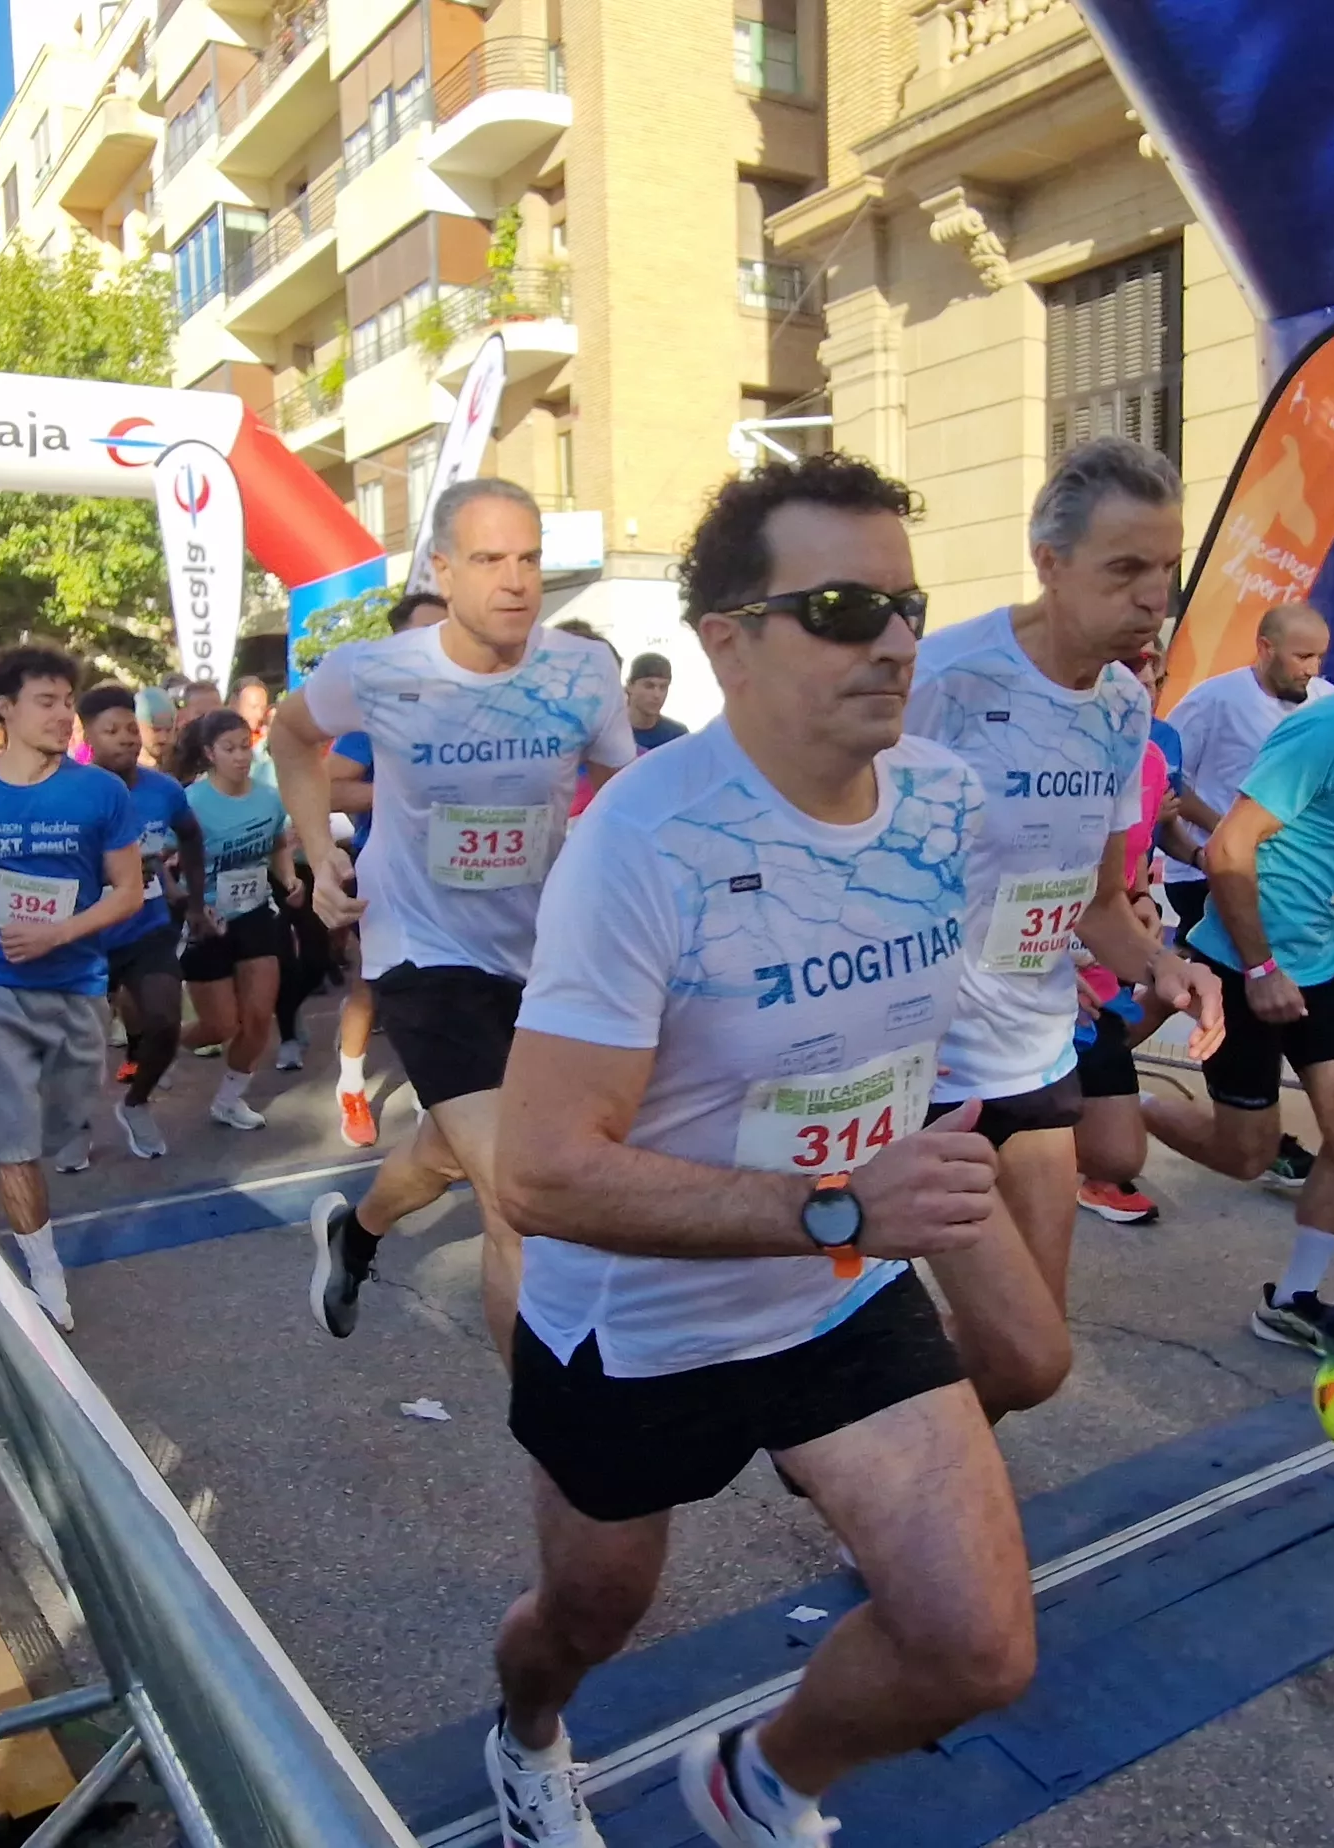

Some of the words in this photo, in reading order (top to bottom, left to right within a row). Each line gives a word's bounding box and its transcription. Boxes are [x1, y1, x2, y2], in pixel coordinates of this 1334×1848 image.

[439, 736, 562, 765] COGITIAR
[458, 829, 524, 854] 313
[450, 855, 527, 869] FRANCISO
[229, 881, 258, 896] 272
[8, 892, 57, 916] 394
[1020, 900, 1082, 937] 312
[801, 917, 962, 998] COGITIAR
[1019, 954, 1045, 968] 8K
[828, 1066, 895, 1100] CARRERA
[792, 1105, 894, 1167] 314
